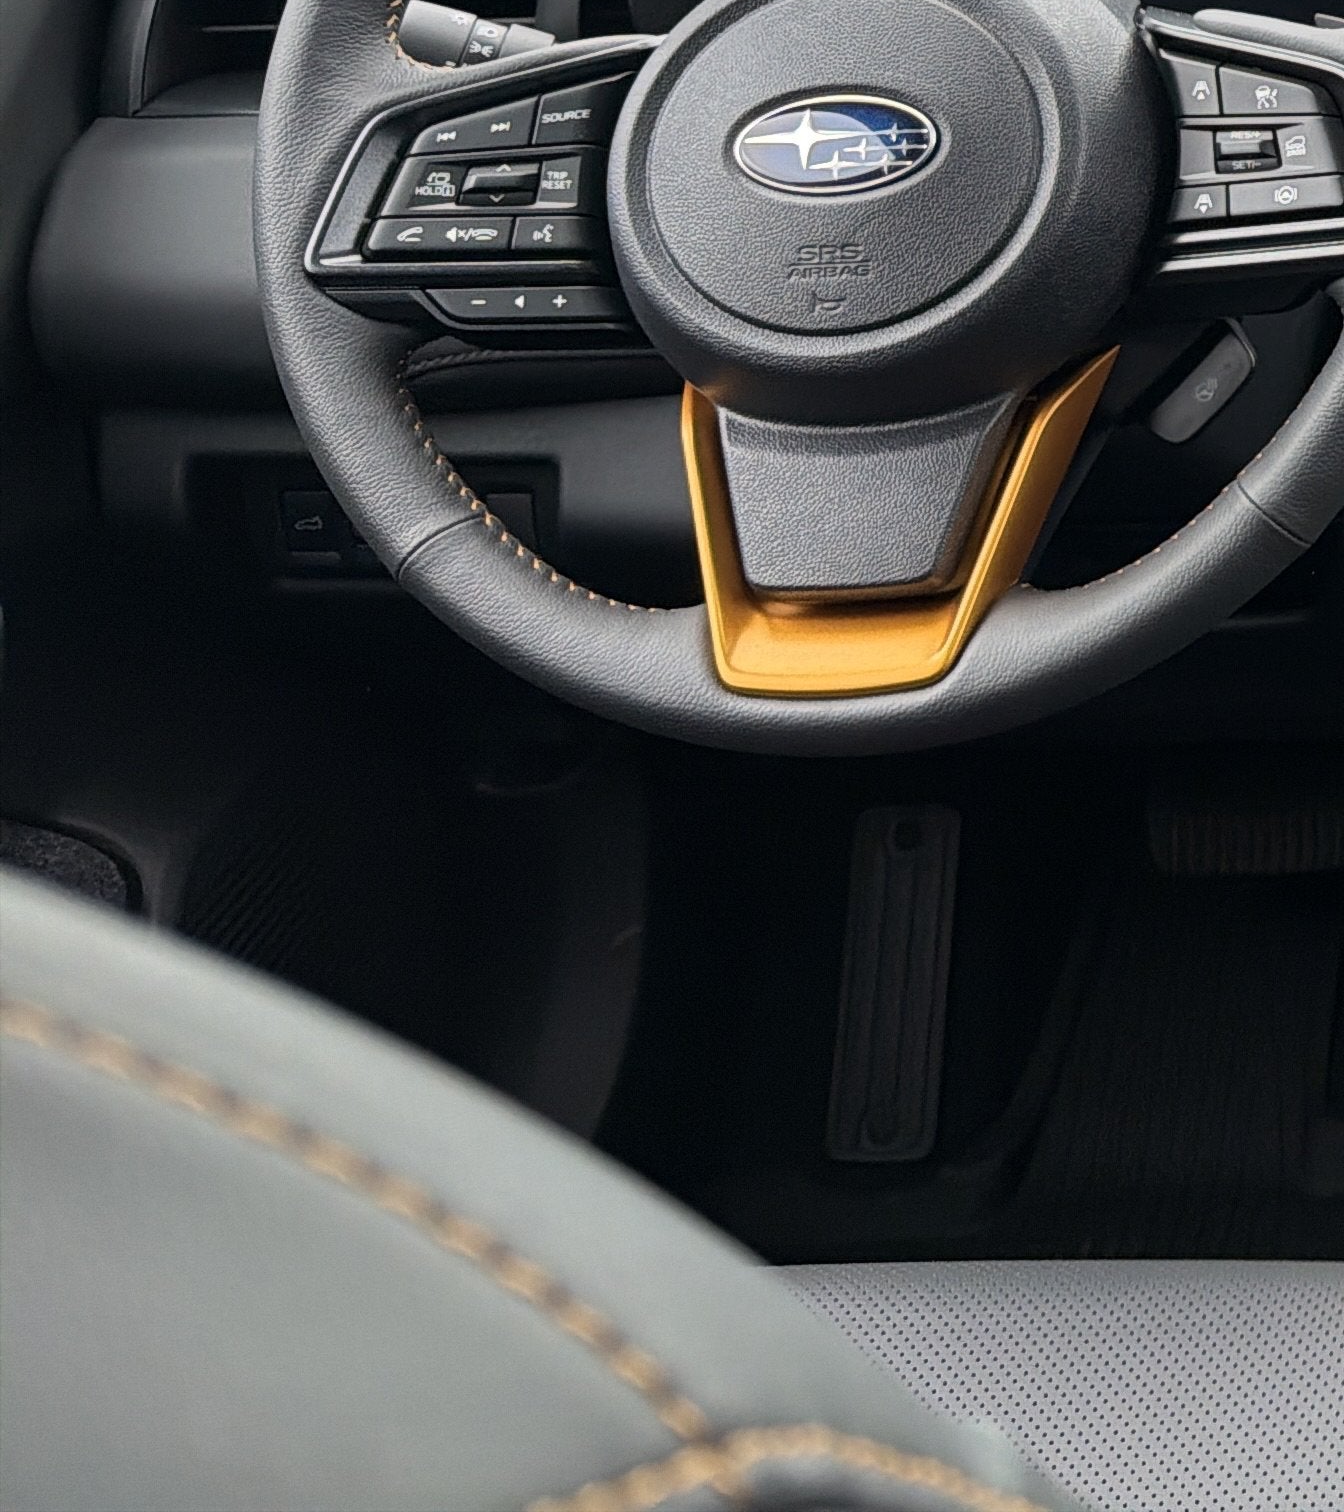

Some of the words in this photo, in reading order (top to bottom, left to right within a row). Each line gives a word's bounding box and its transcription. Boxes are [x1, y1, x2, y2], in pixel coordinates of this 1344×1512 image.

[541, 109, 592, 124] SOURCE
[547, 171, 569, 179] TRIP
[414, 186, 445, 196] HOLD
[541, 179, 573, 190] RESET
[797, 243, 863, 262] SRS
[786, 263, 872, 279] AIRBAG
